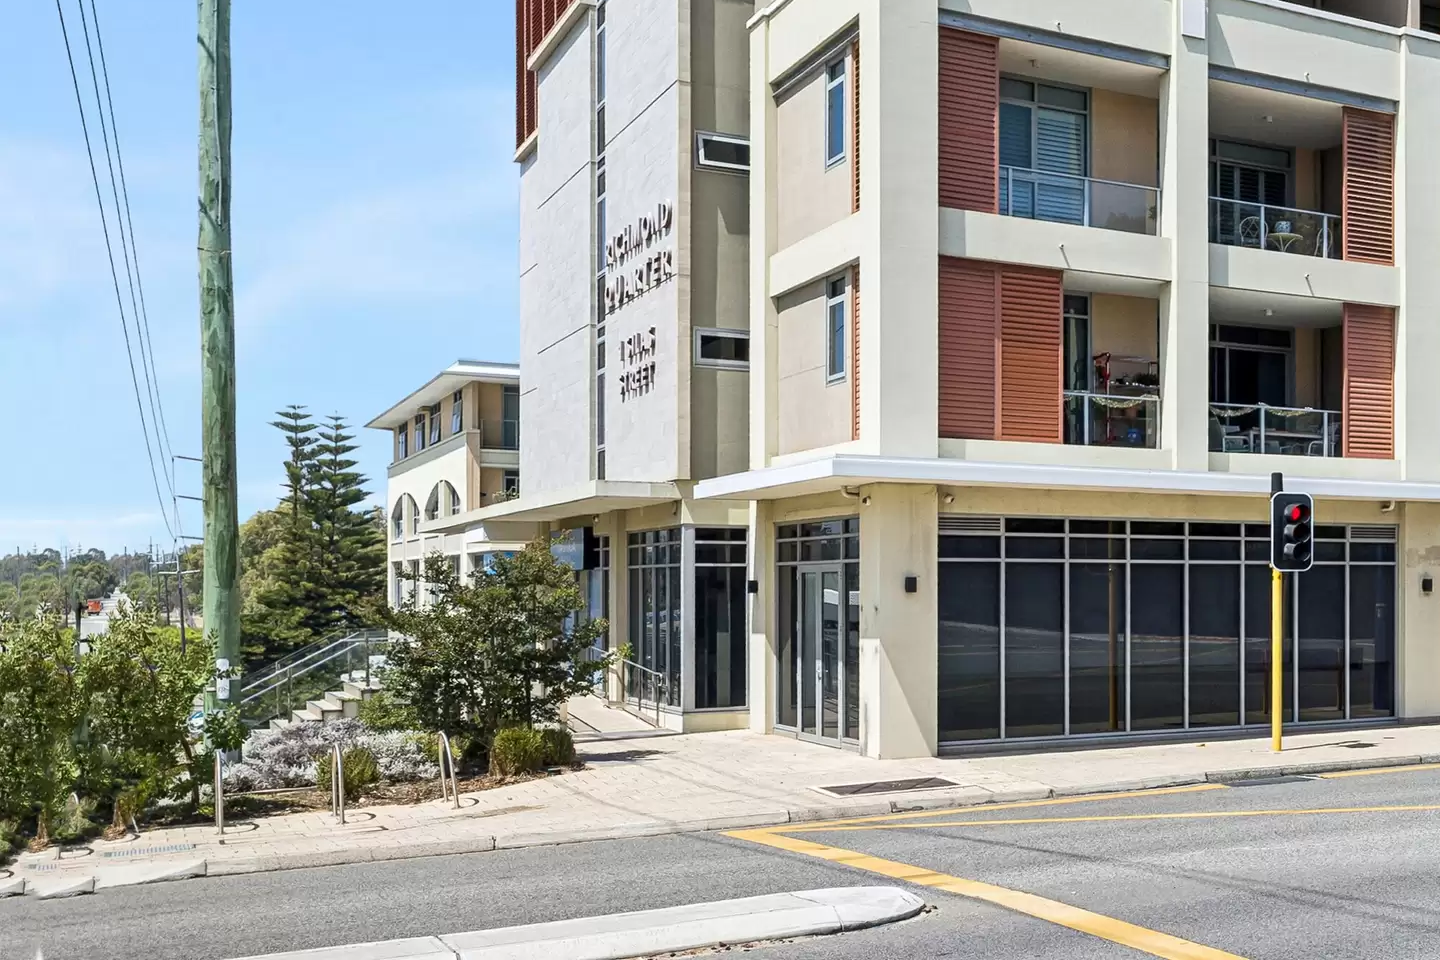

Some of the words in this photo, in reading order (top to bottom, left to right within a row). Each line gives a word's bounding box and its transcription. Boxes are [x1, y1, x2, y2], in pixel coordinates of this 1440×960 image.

[605, 199, 673, 271] RICHMOND
[604, 247, 673, 315] QUARTER
[619, 361, 656, 402] STREET
